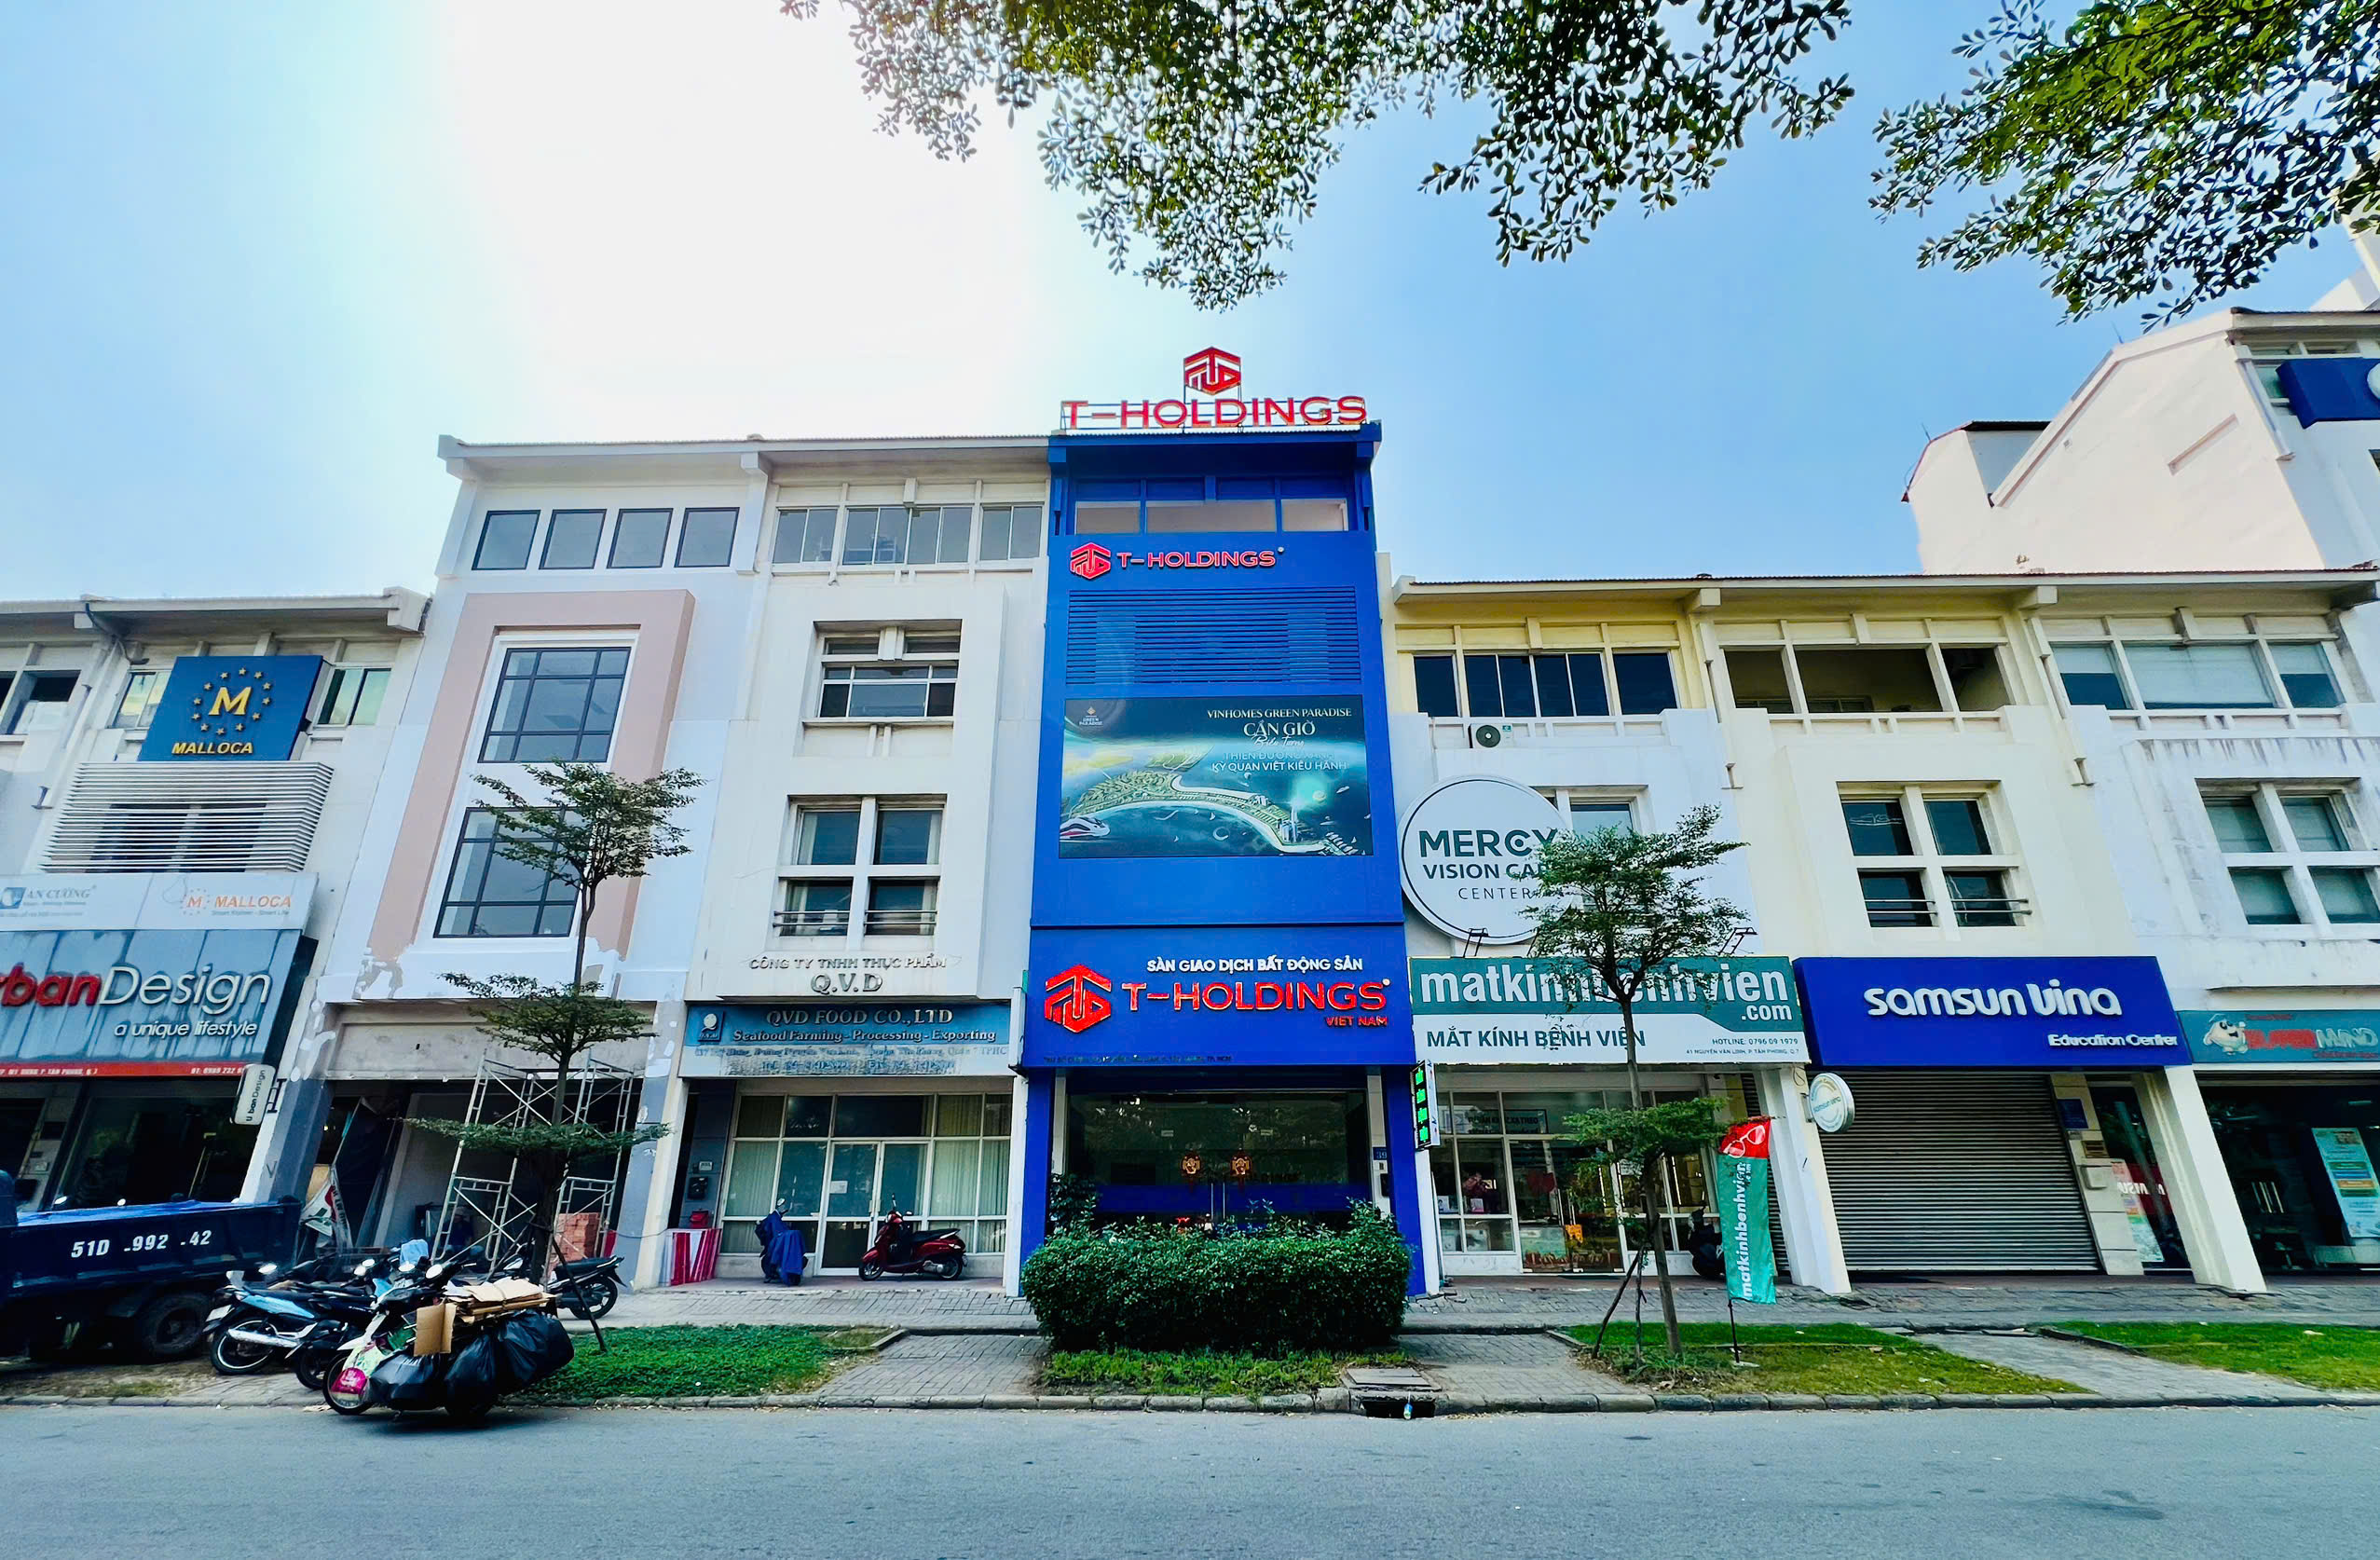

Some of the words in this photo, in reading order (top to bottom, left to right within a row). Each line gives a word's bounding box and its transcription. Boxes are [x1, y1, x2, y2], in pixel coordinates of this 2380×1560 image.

[1060, 396, 1367, 429] T-HOLDINGS
[1116, 550, 1276, 568] T-HOLDINGS
[1208, 709, 1263, 718] VINHOMES
[1265, 708, 1300, 718] GREEN
[1302, 708, 1352, 718] PARADISE
[1244, 719, 1279, 736] CẦN
[1283, 719, 1316, 736] GIỜ
[171, 742, 253, 755] MALLOCA
[1228, 762, 1260, 772] QUAN
[1263, 761, 1286, 772] VIỆT
[1418, 828, 1558, 857] MERCY
[1423, 864, 1499, 879] VISION
[1458, 887, 1533, 899] CENTER
[215, 896, 291, 908] MALLOCA
[749, 956, 789, 969] CÔNG
[795, 959, 814, 969] TY
[818, 958, 858, 968] TNHH
[863, 958, 901, 970] THỰC
[1147, 955, 1175, 972] SÀN
[1179, 959, 1216, 972] GIAO
[1219, 958, 1254, 975] DỊCH
[1257, 955, 1283, 971] BẤT
[1287, 956, 1331, 973] ĐỘNG
[1334, 955, 1363, 971] SẢN
[811, 973, 882, 995] Q.V.D
[1121, 981, 1388, 1011] T-HOLDINGS
[1864, 988, 2027, 1016] samsun
[767, 1010, 809, 1026] QVD
[815, 1009, 868, 1024] FOOD
[1325, 1016, 1353, 1026] VIET
[1358, 1016, 1388, 1026] NAM
[1741, 1005, 1793, 1020] .com
[114, 1024, 125, 1036] a
[132, 1020, 188, 1039] unique
[194, 1019, 258, 1039] lifestyle
[733, 1030, 786, 1042] Seafood
[790, 1030, 842, 1042] Farming
[853, 1030, 922, 1042] Processing
[932, 1030, 996, 1042] Exporting
[1427, 1026, 1471, 1047] MẮT
[1479, 1026, 1529, 1047] KÍNH
[1536, 1027, 1591, 1050] BỆNH
[2047, 1033, 2125, 1046] Education
[2126, 1033, 2178, 1046] Center
[71, 1239, 110, 1258] 51D
